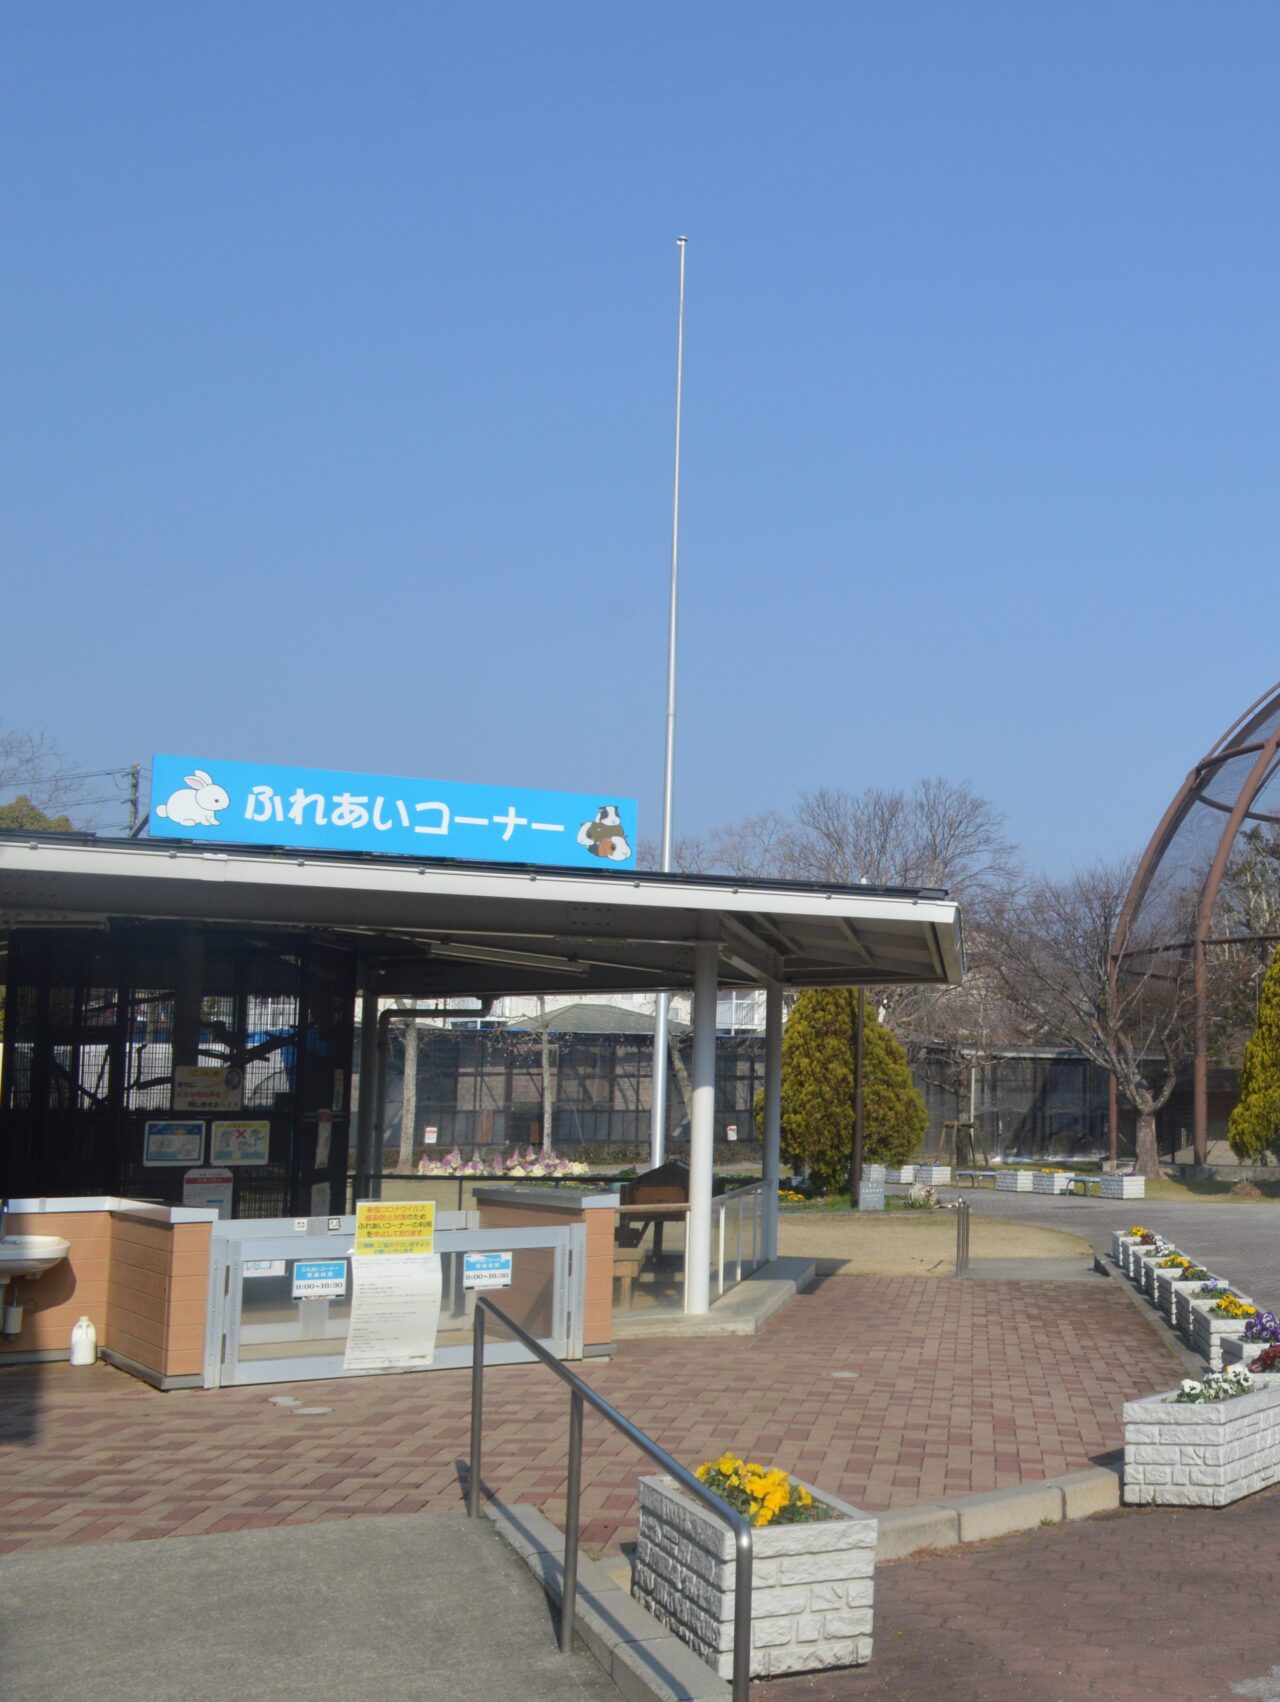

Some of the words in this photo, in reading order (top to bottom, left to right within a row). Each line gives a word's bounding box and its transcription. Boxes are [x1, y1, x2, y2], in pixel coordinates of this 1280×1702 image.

[244, 785, 564, 842] ふれあいコーナー
[367, 1205, 426, 1214] 新型コロナウイルス
[358, 1221, 433, 1230] ふれあいコーナーの利用
